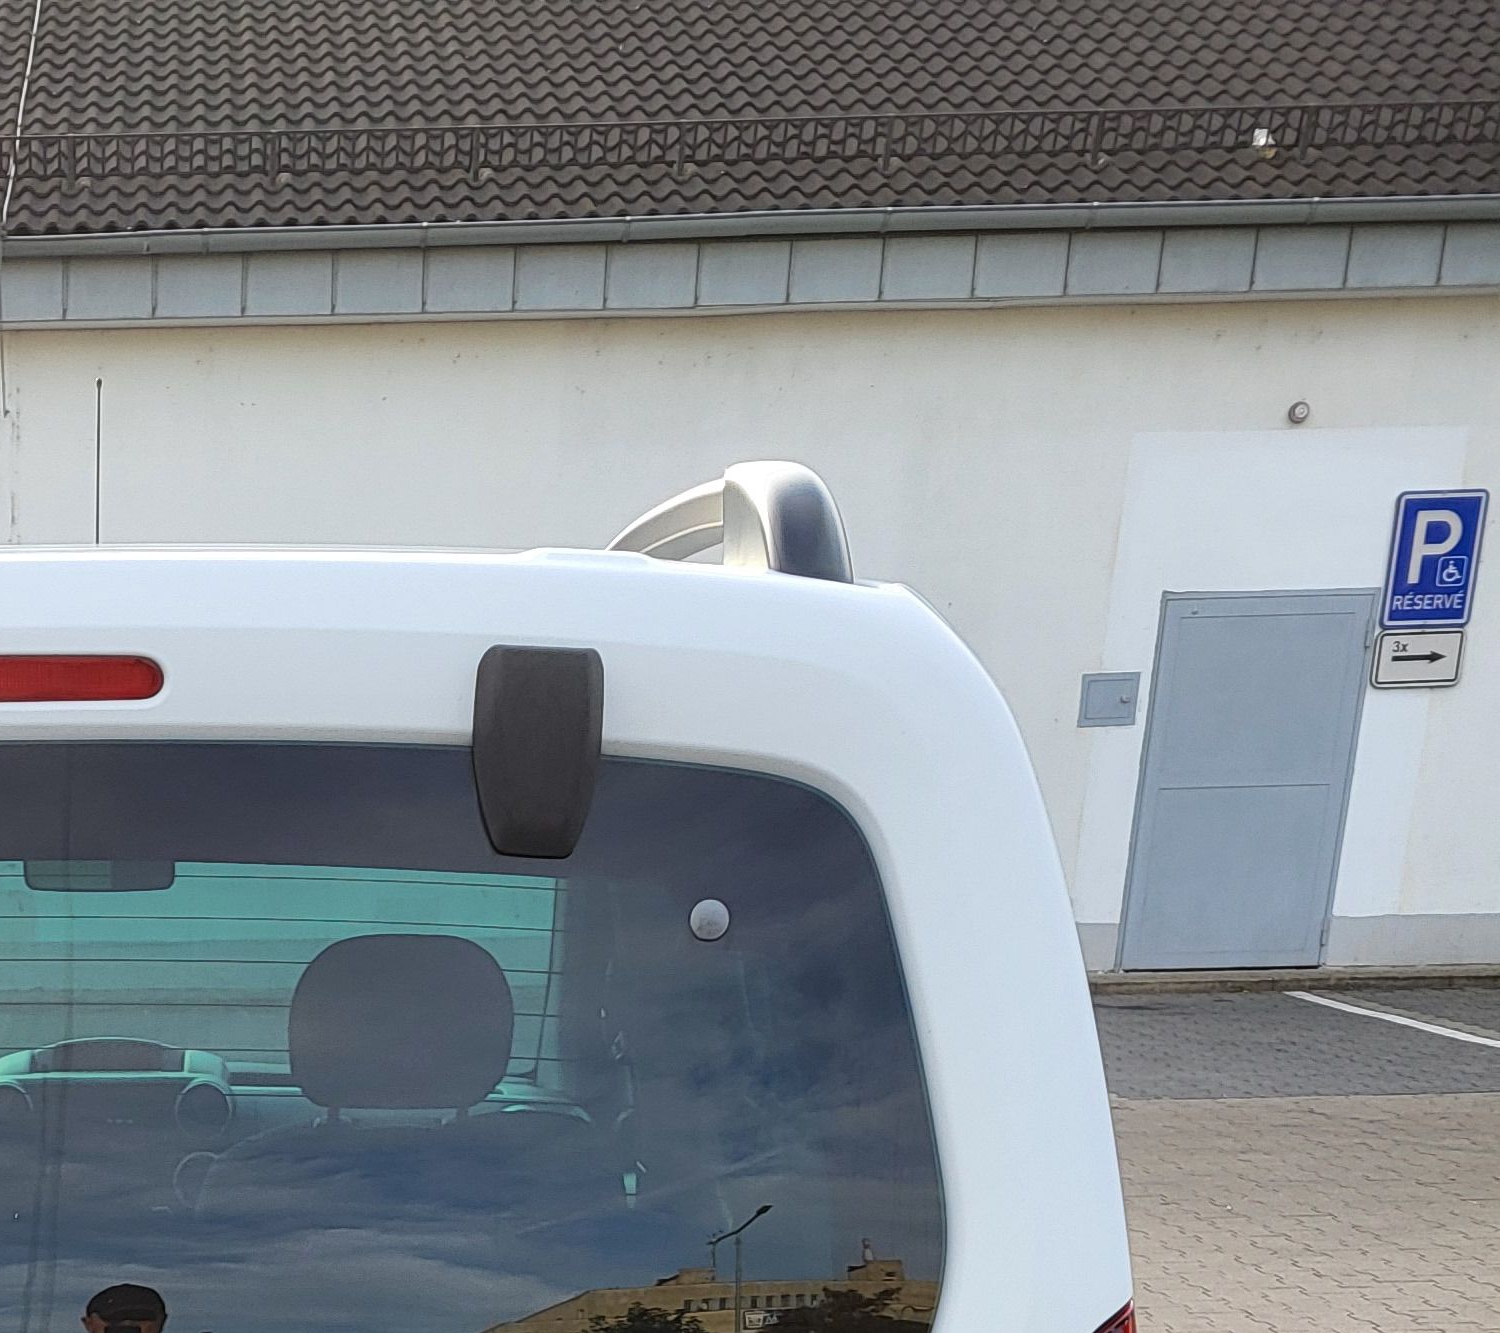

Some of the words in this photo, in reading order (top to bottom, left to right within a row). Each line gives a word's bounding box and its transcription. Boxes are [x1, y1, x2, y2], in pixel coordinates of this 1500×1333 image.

[1407, 509, 1463, 584] P
[1392, 590, 1465, 611] RÉSERVÉ
[1392, 641, 1408, 652] 3x
